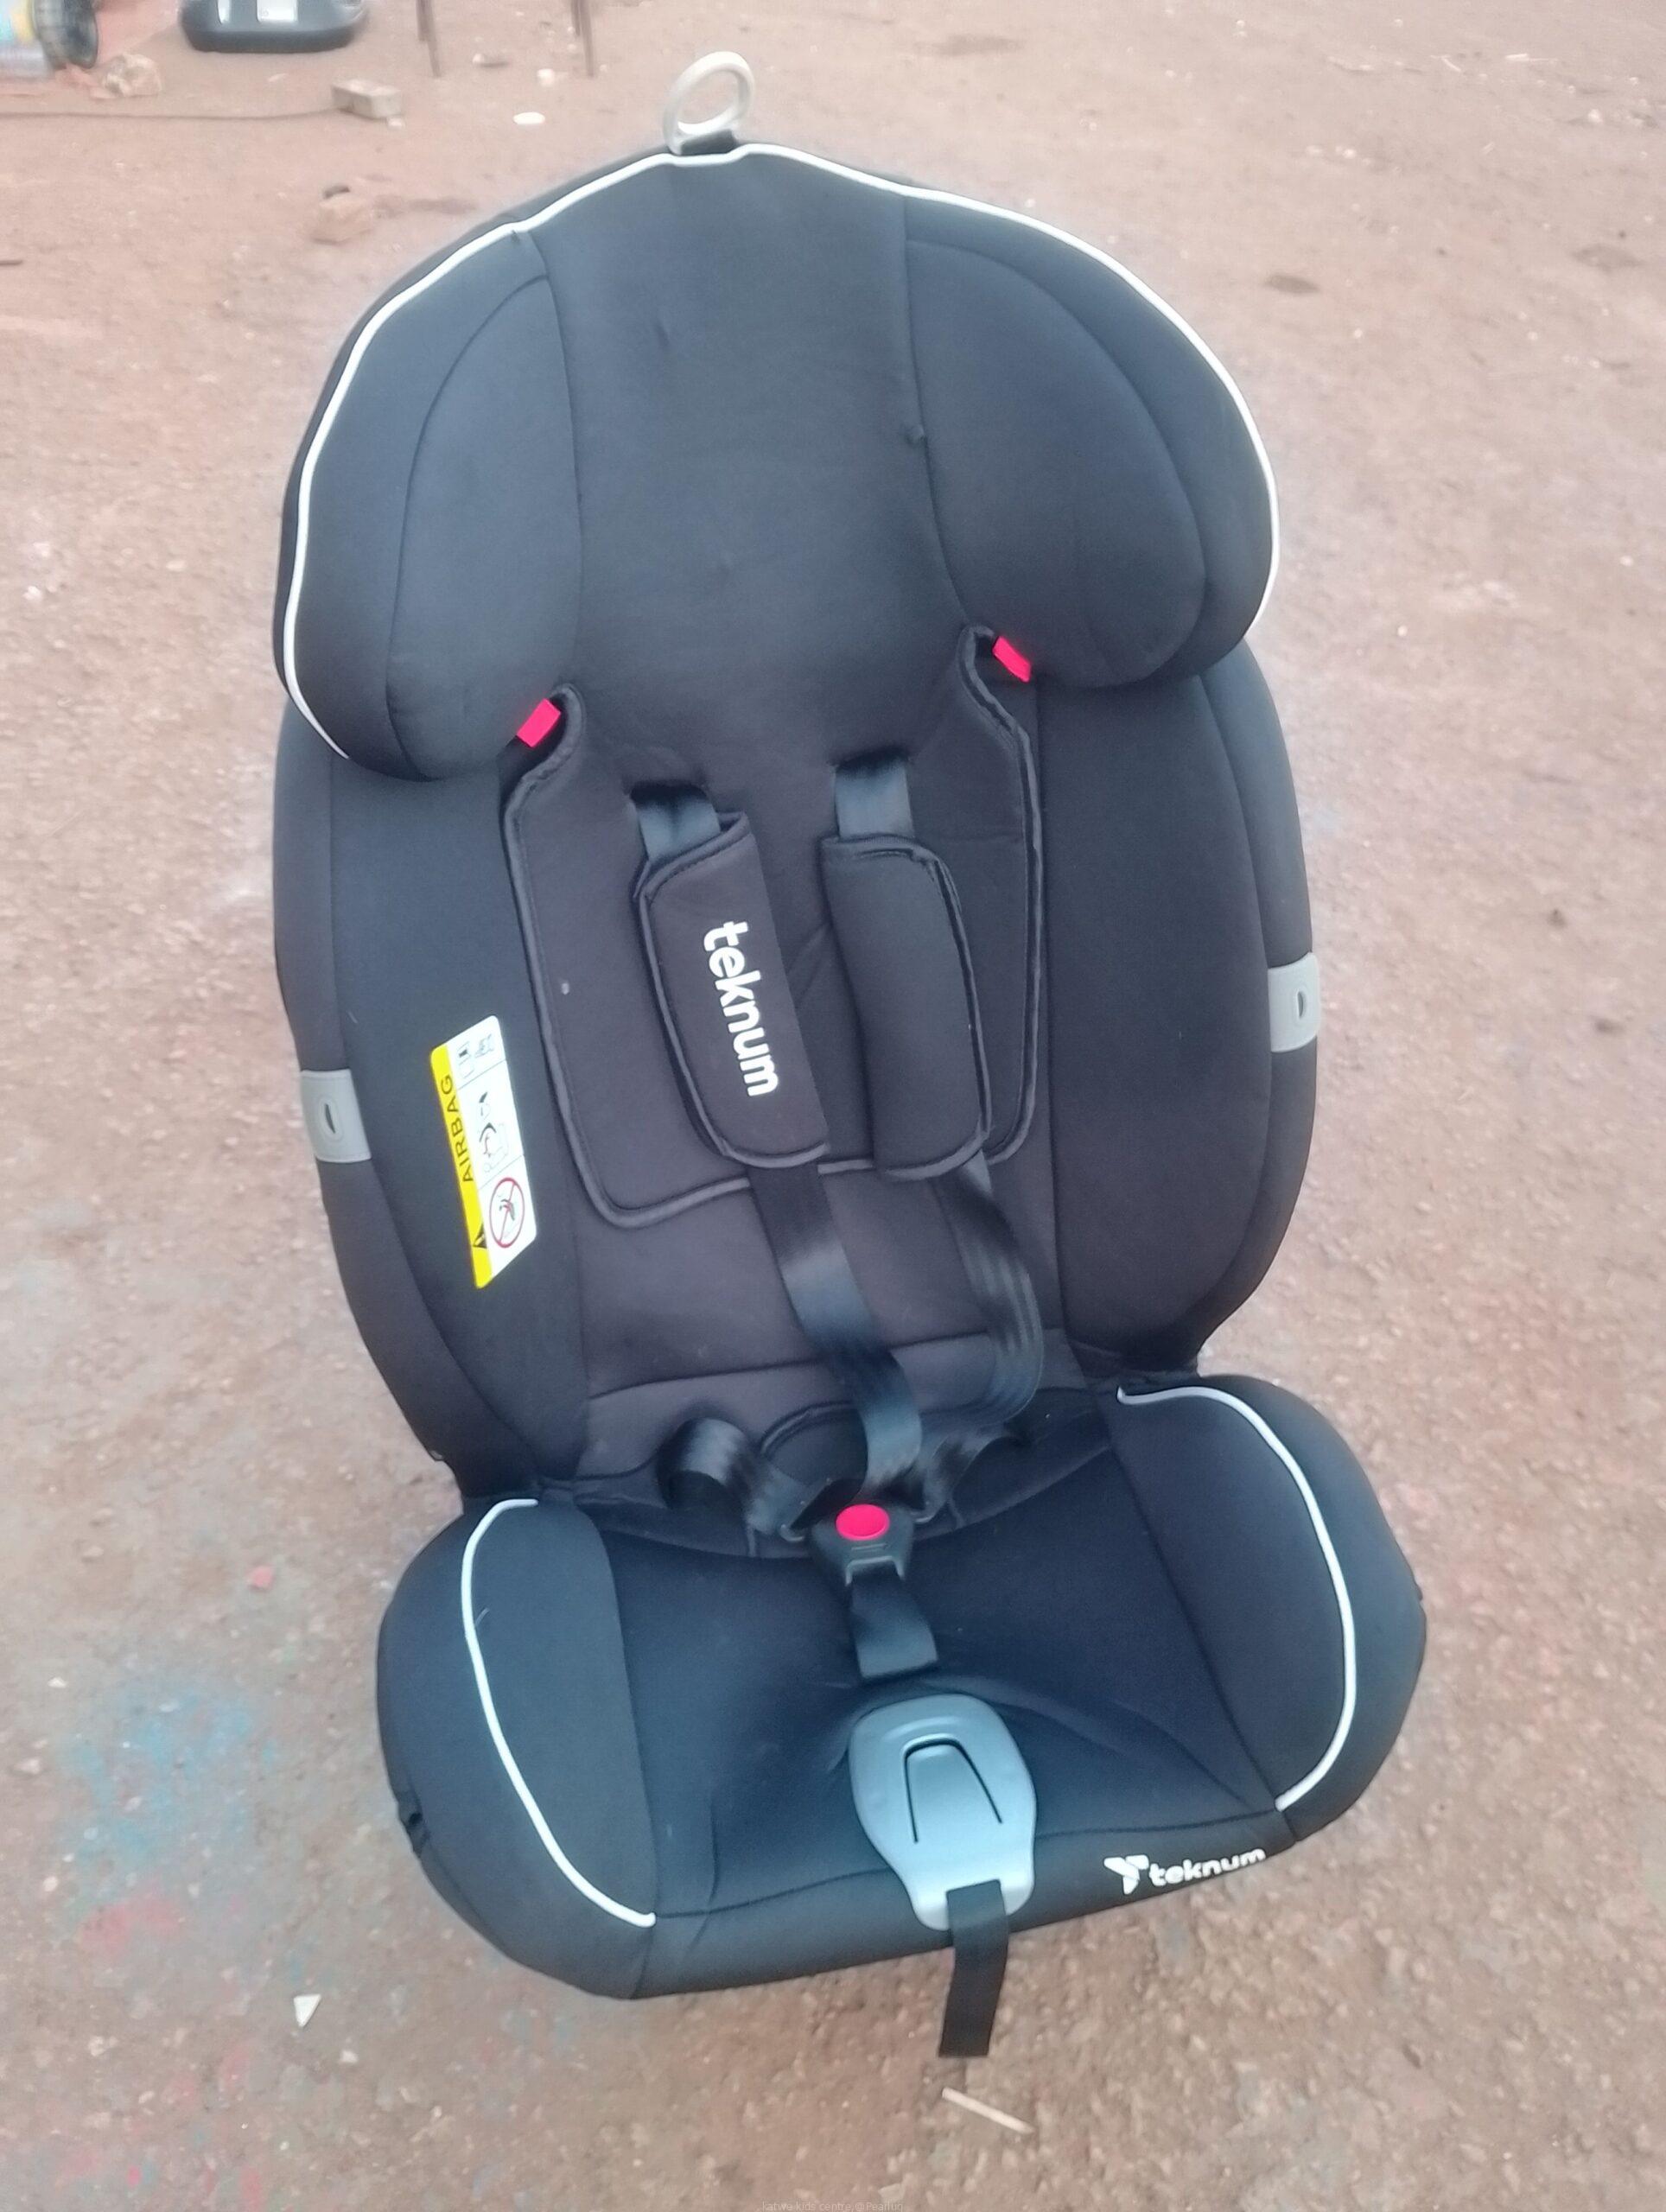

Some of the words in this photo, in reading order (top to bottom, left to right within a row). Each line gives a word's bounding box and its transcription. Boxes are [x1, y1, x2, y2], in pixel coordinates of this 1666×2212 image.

[703, 920, 779, 1096] teknum
[440, 1074, 474, 1183] AIRBAG
[1148, 1847, 1267, 1887] teknum
